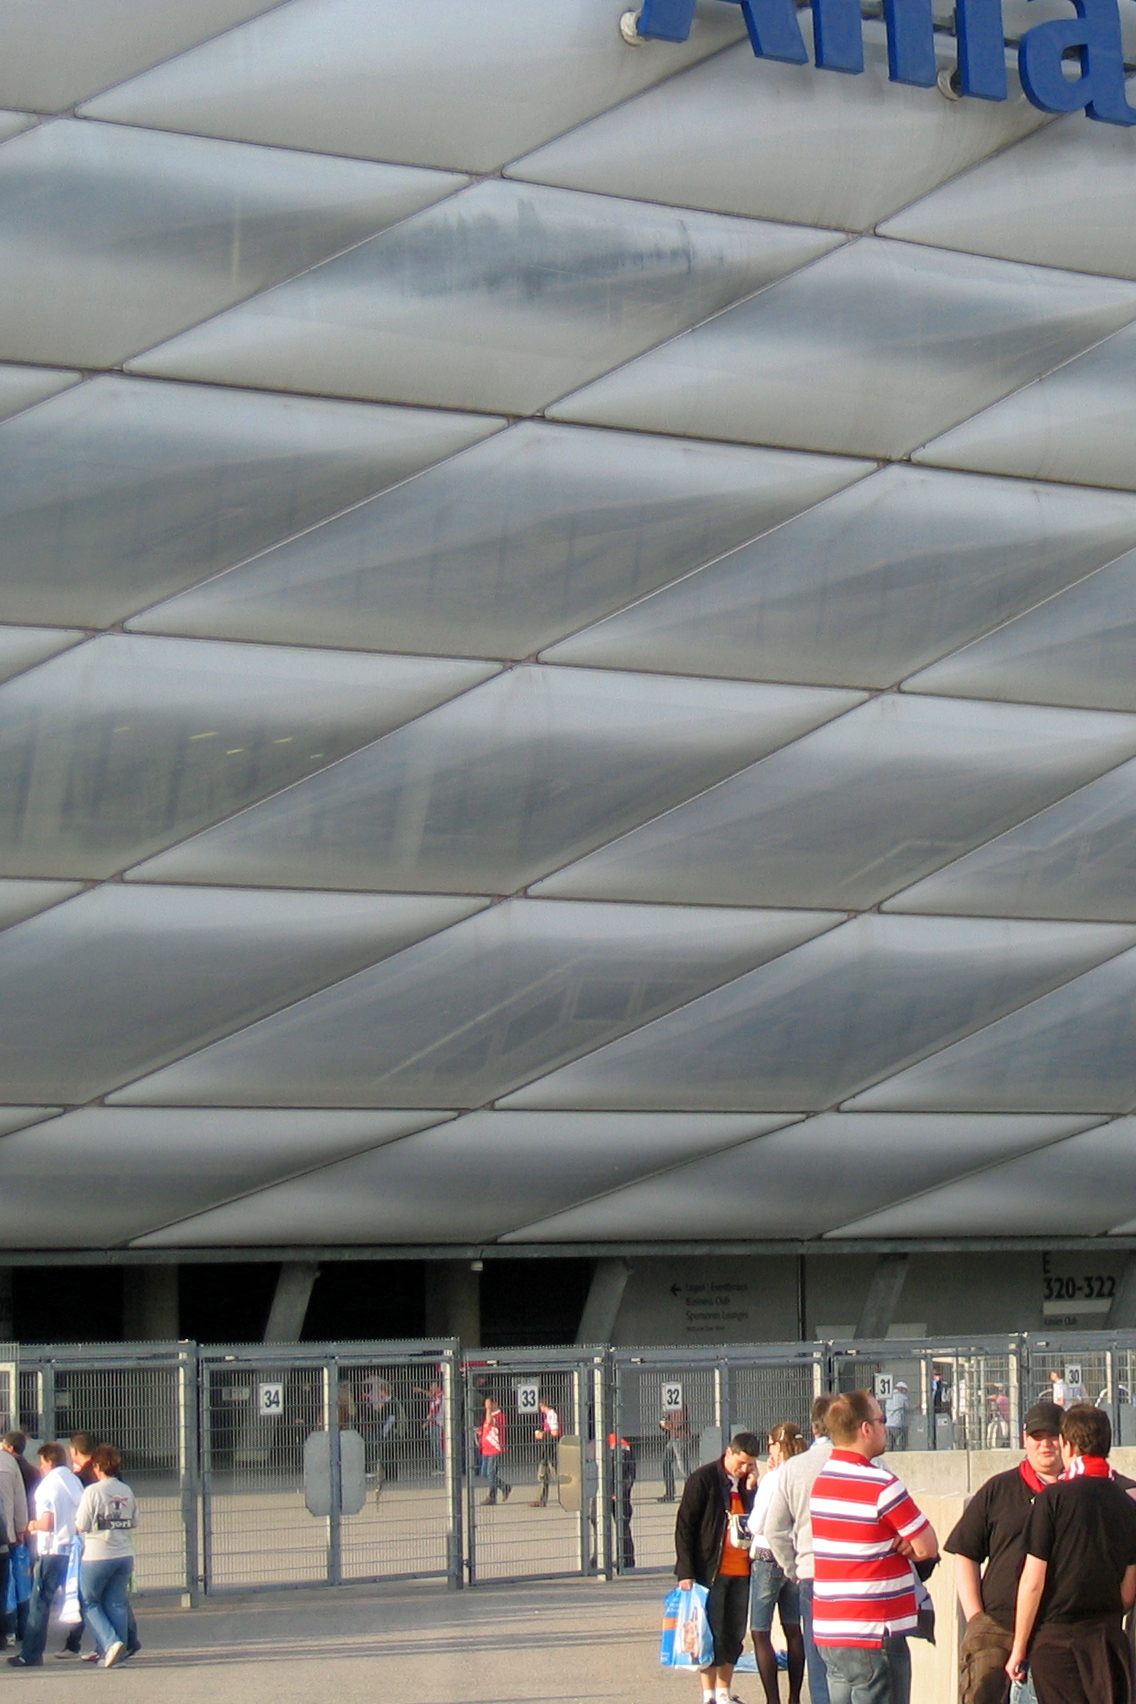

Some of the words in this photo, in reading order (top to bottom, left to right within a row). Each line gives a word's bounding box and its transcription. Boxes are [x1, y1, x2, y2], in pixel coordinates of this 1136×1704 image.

[1043, 1251, 1051, 1274] E
[1043, 1275, 1116, 1299] 320-322
[1069, 1369, 1080, 1384] 30
[880, 1378, 891, 1394] 31
[264, 1389, 280, 1408] 34
[522, 1389, 536, 1407] 33
[666, 1388, 680, 1405] 32
